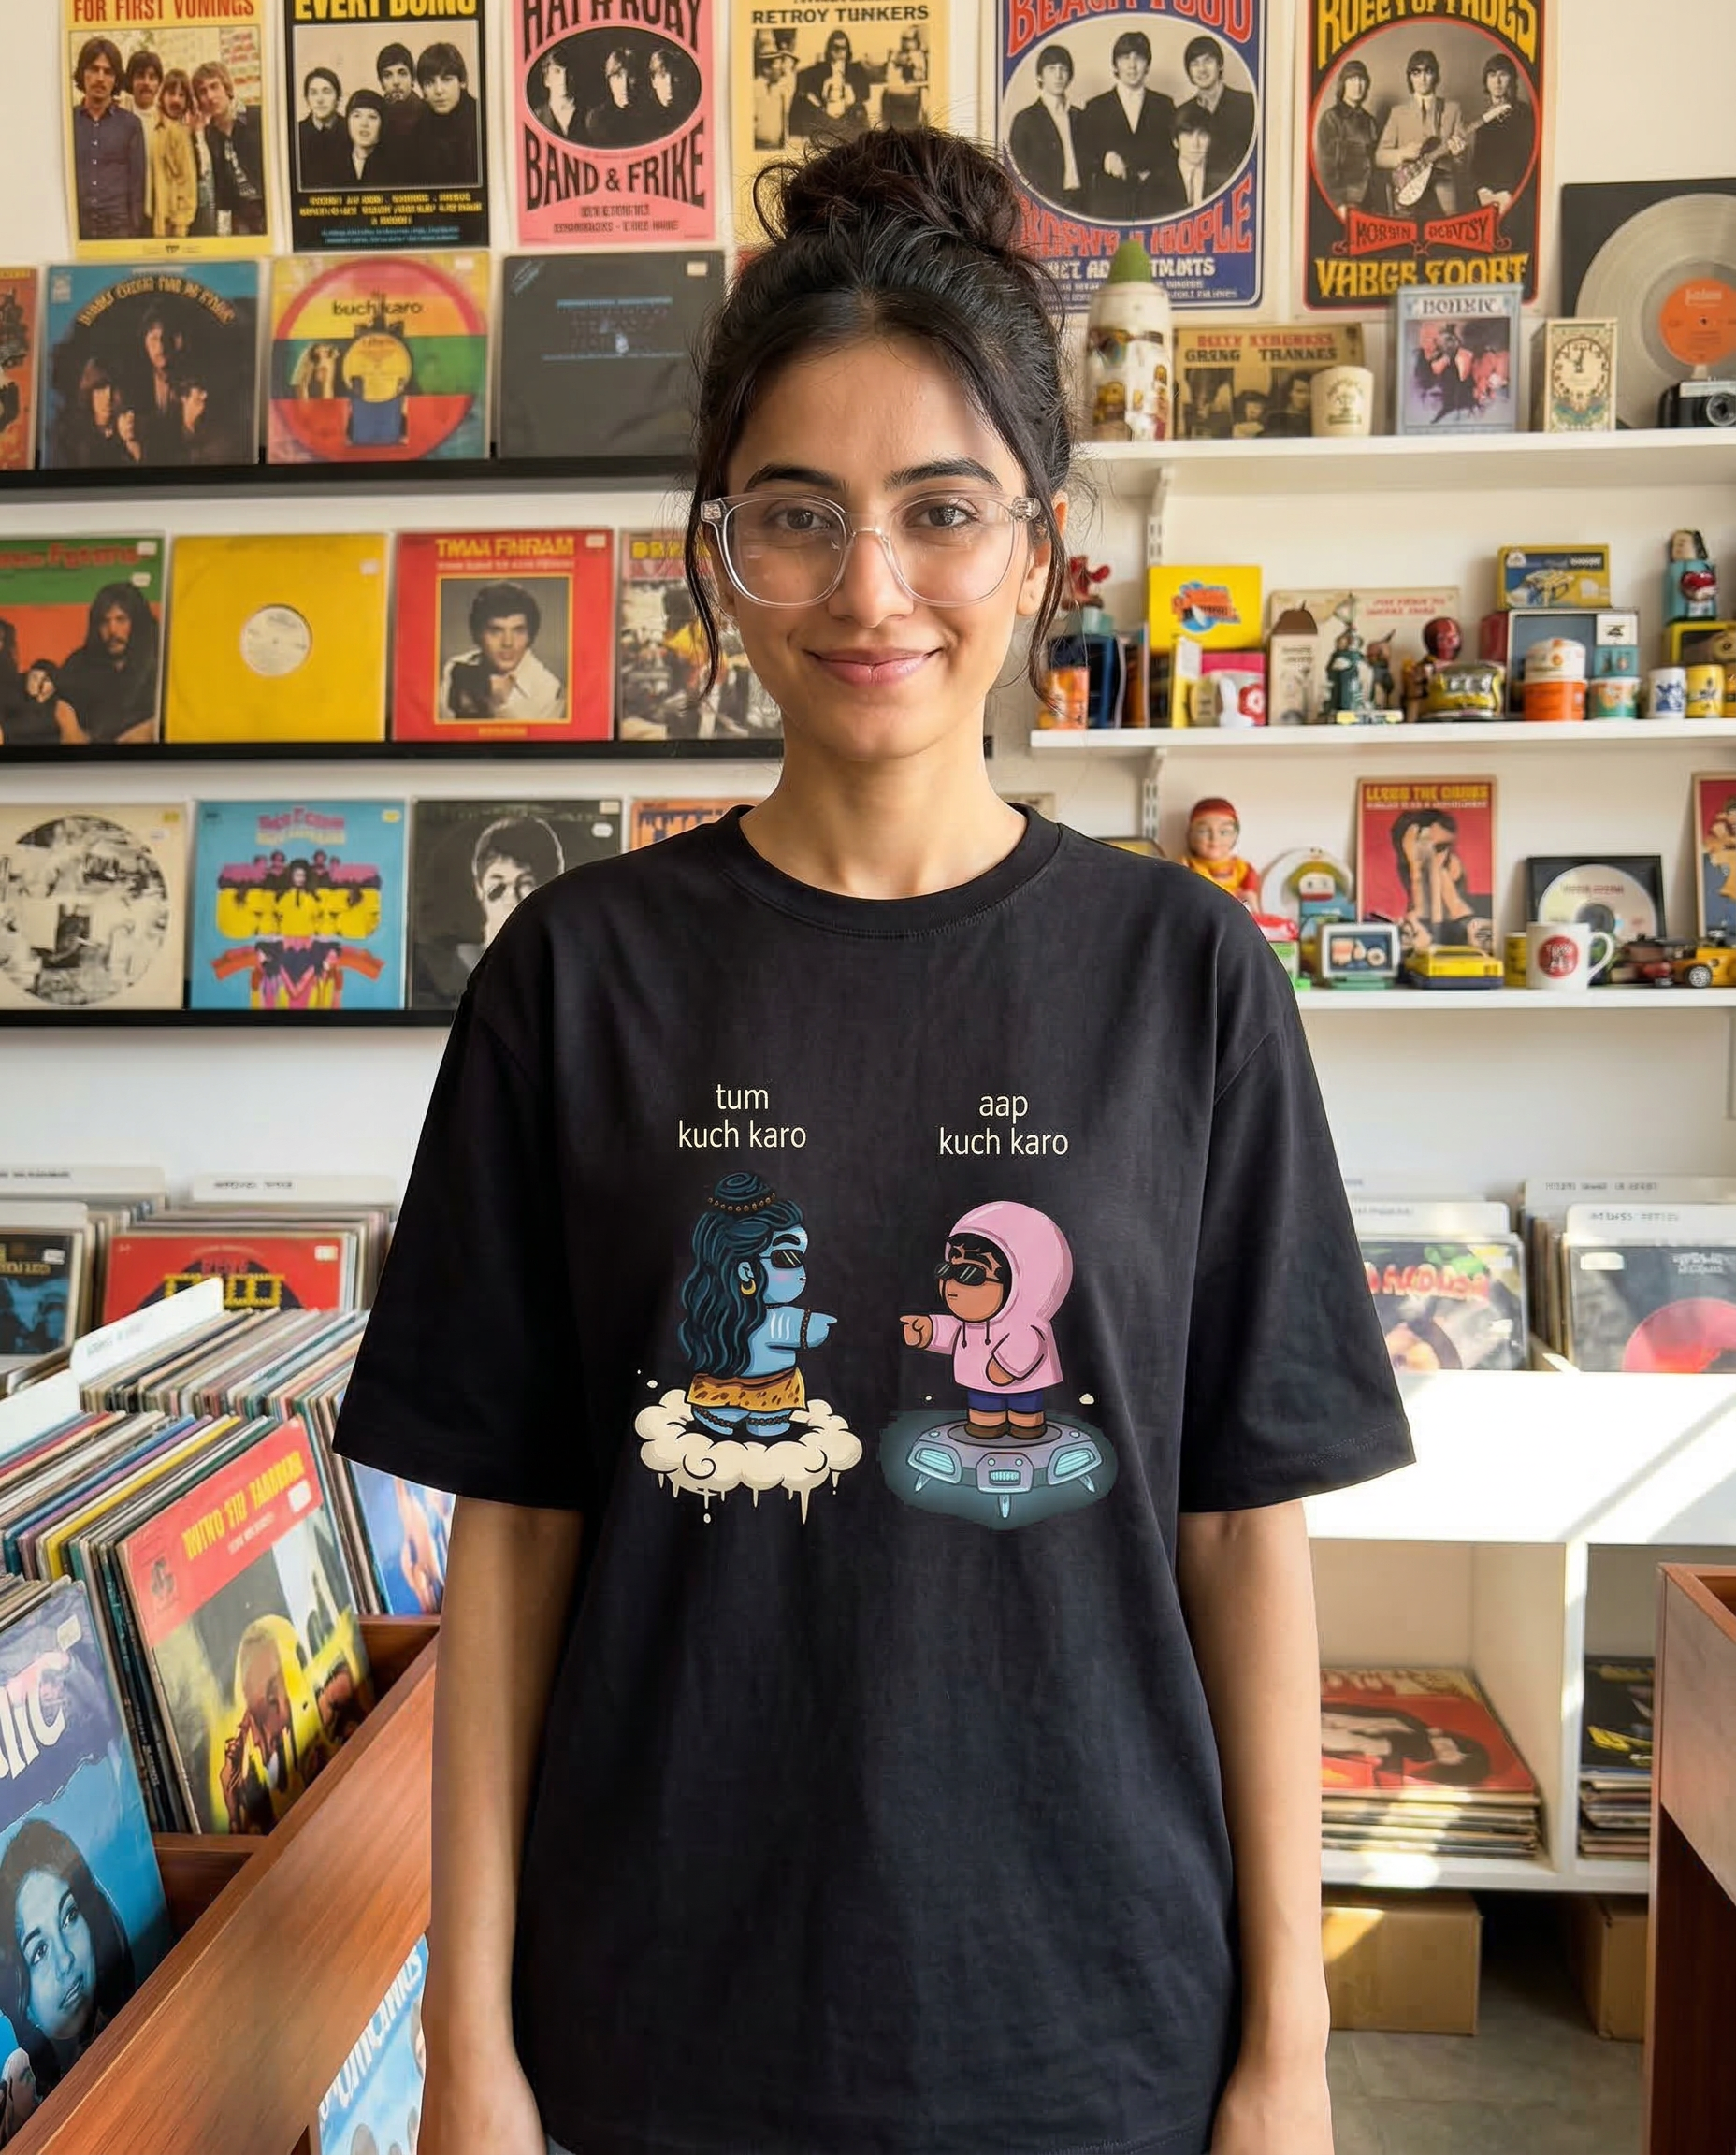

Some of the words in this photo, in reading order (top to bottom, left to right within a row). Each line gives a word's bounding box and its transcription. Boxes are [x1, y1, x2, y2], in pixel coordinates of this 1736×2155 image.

[752, 9, 829, 24] RETROY
[835, 6, 929, 22] TUNKERS
[525, 124, 600, 211] BAND
[605, 168, 621, 192] &
[629, 118, 705, 210] FRIKE
[715, 1083, 769, 1110] tum
[978, 1095, 1029, 1125] aap
[678, 1119, 740, 1148] kuch
[749, 1119, 807, 1148] karo
[939, 1126, 1001, 1155] kuch
[1010, 1126, 1069, 1155] karo
